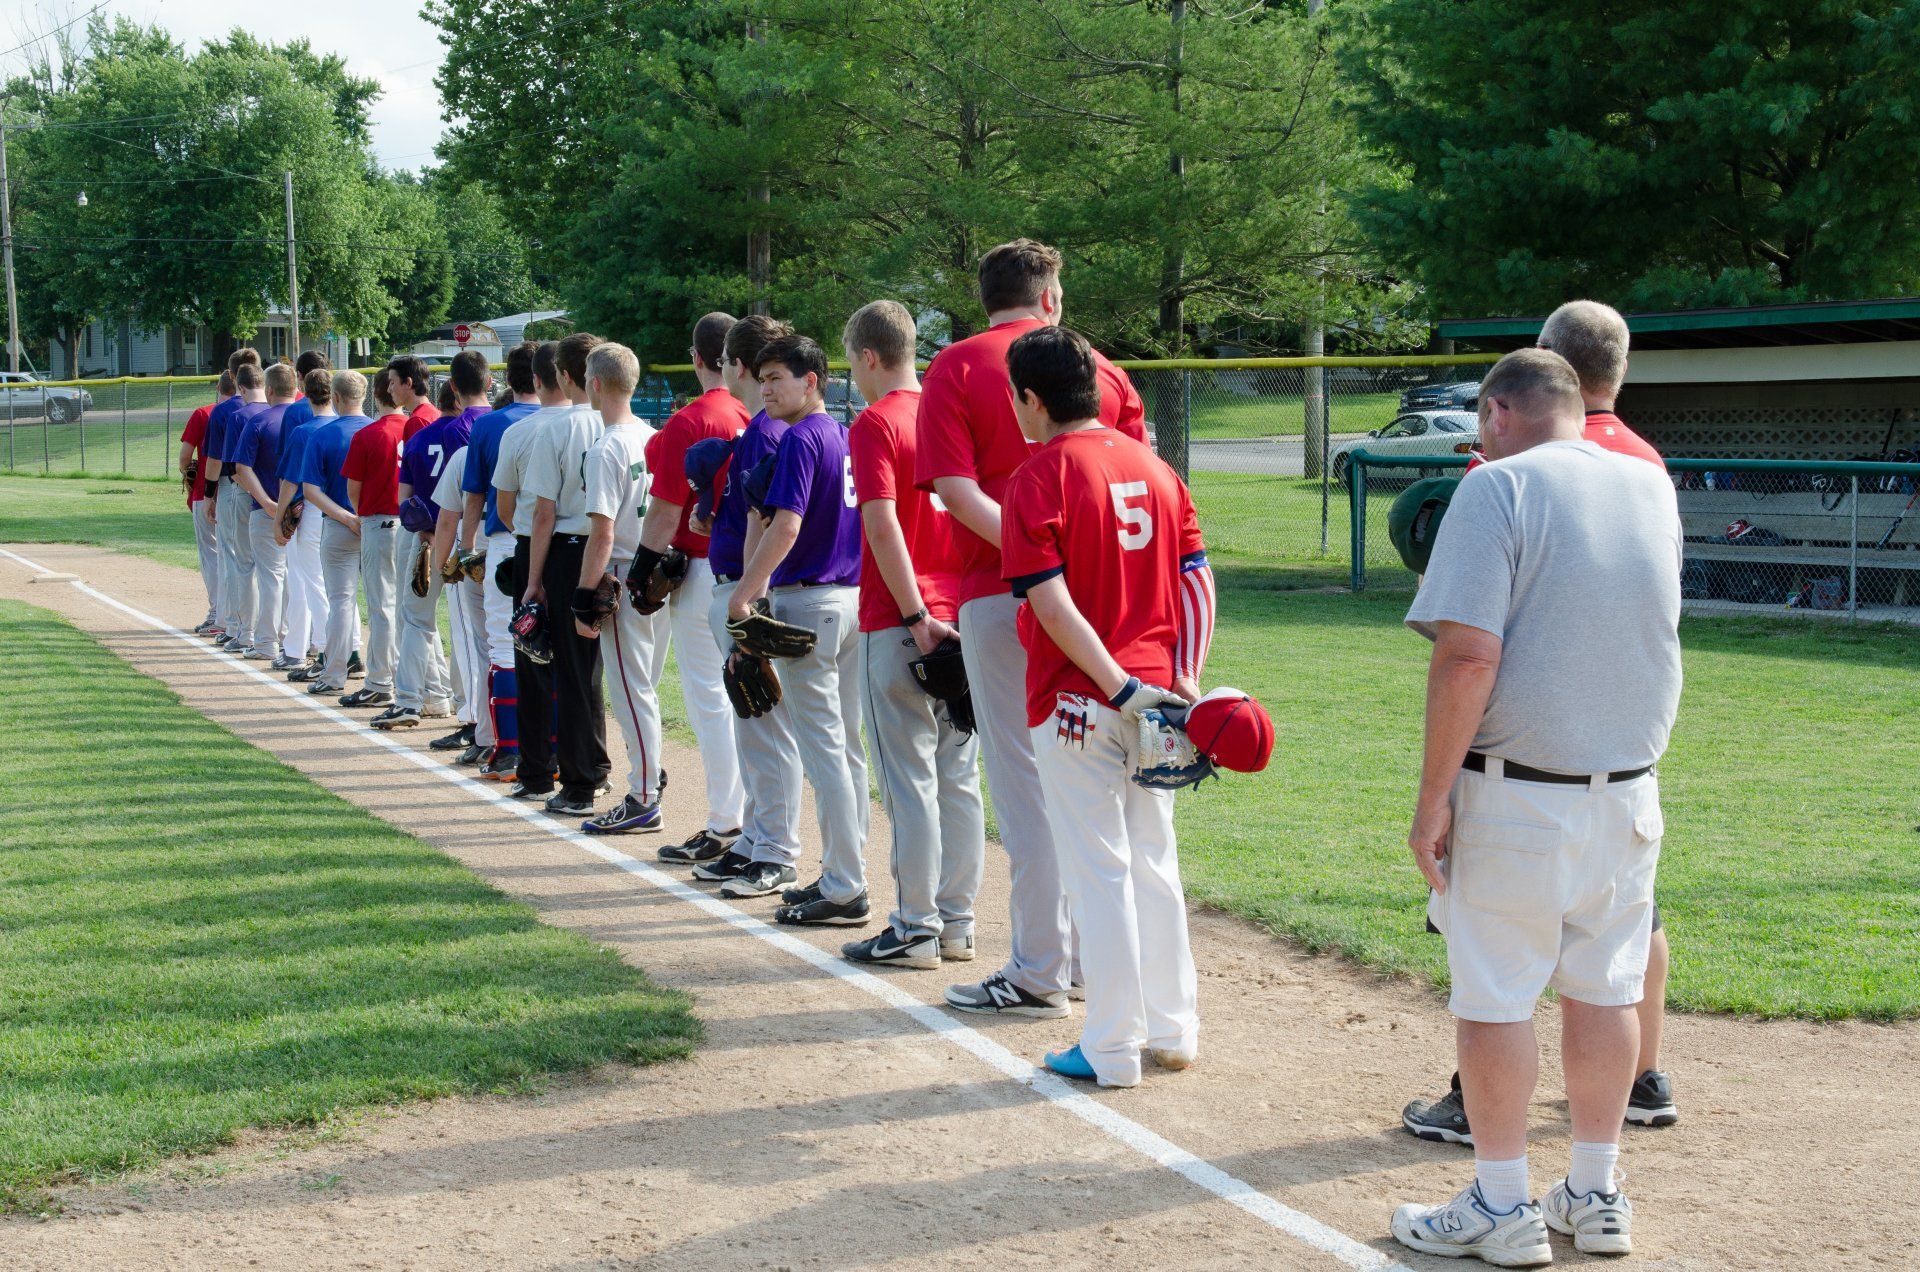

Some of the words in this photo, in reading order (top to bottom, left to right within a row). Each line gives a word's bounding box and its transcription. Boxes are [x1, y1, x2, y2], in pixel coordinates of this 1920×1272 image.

[427, 444, 444, 477] 7
[1109, 480, 1154, 551] 5
[988, 980, 1022, 1008] N
[1441, 1214, 1463, 1233] N
